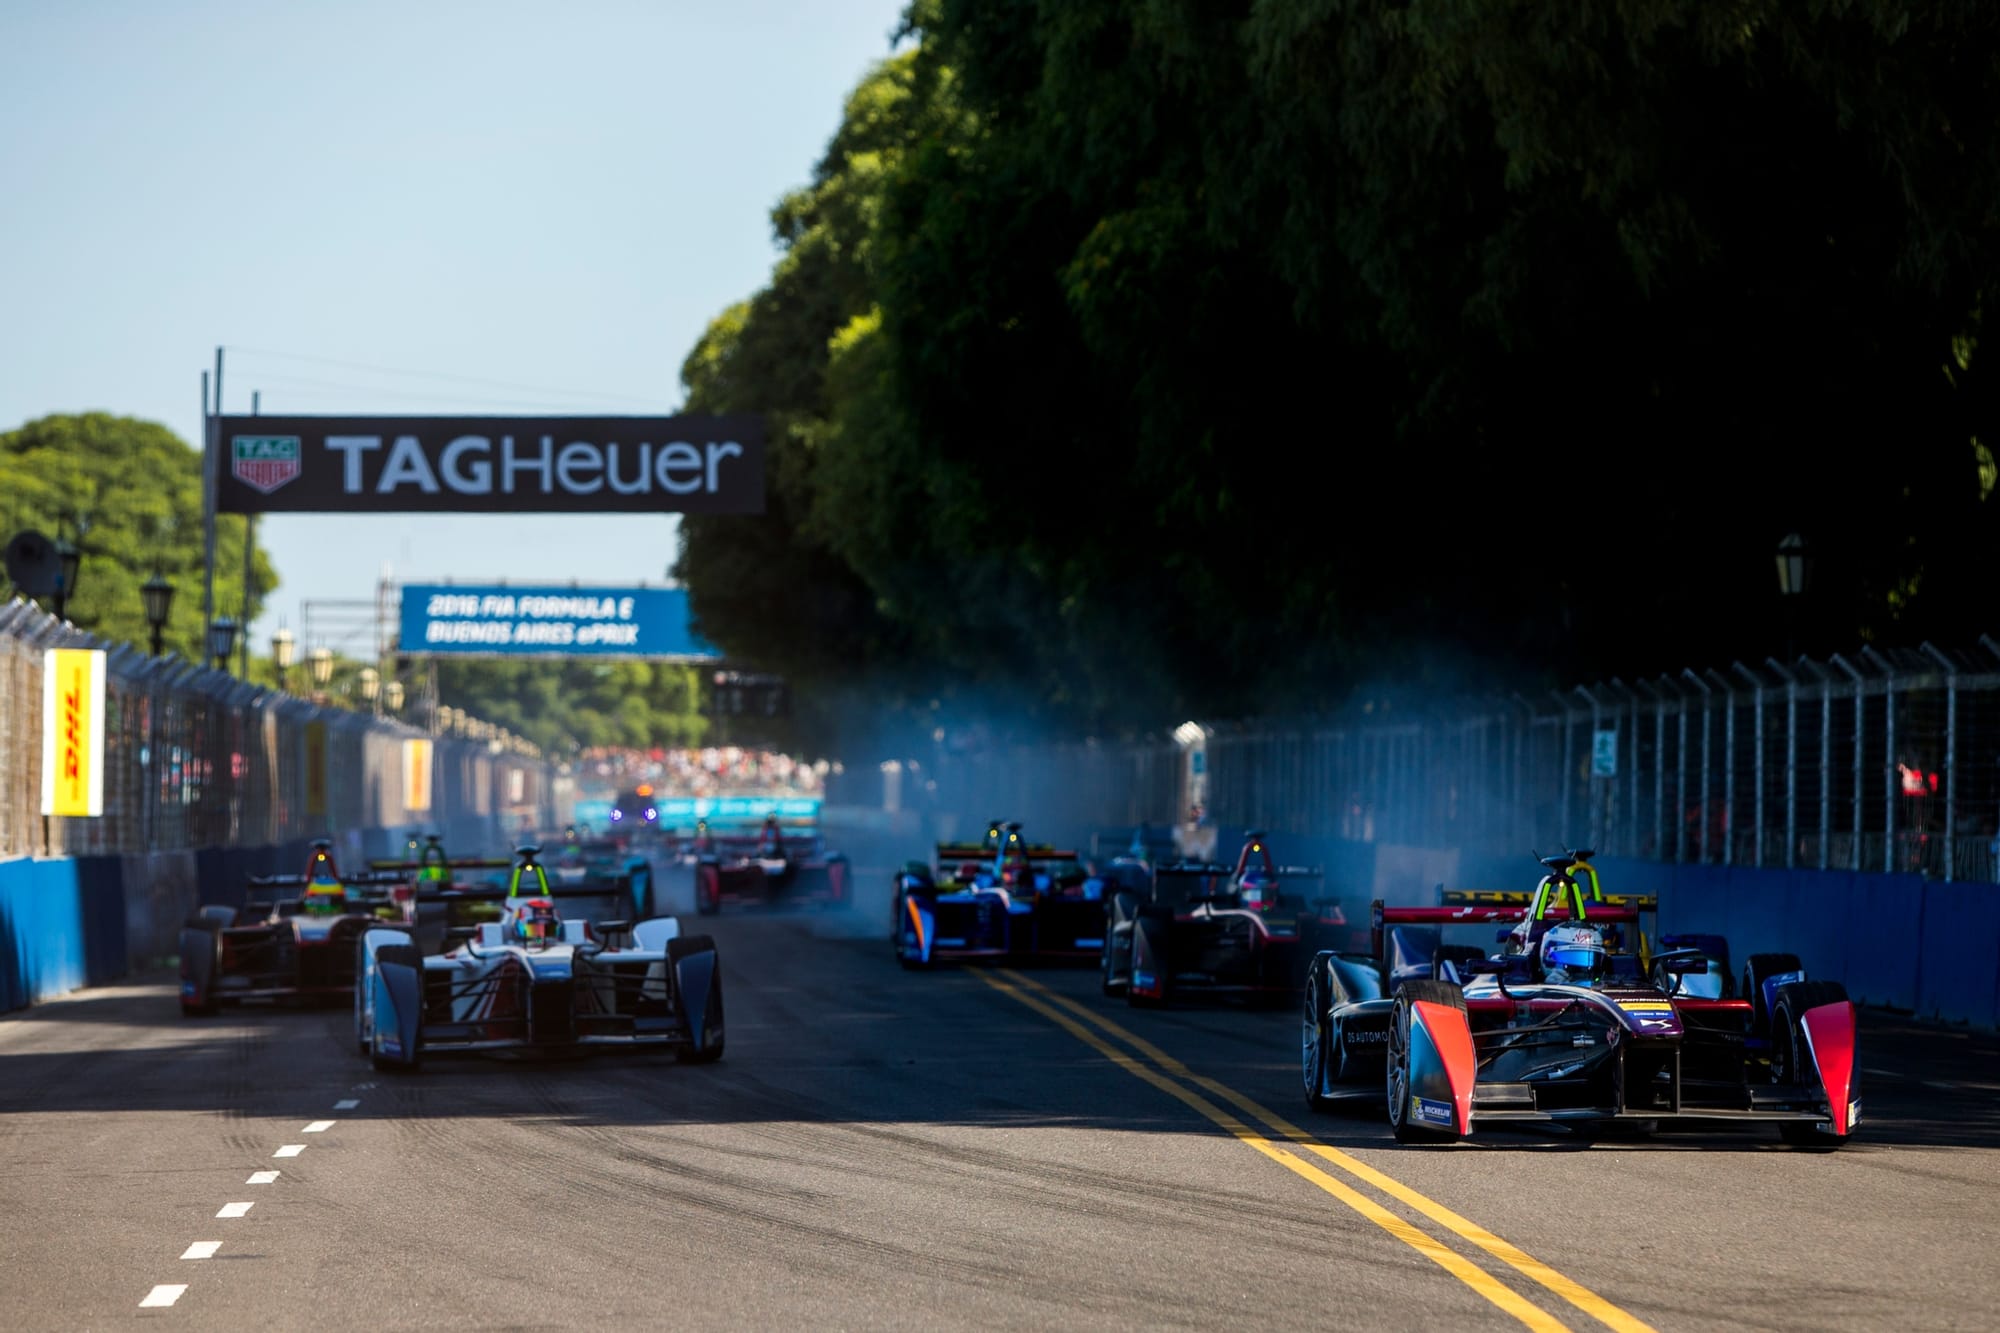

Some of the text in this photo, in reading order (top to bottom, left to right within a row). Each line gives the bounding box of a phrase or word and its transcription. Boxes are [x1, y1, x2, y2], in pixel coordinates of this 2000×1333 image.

[239, 438, 294, 458] TAG
[427, 594, 634, 620] 2016 FIA FORMULA E
[426, 620, 513, 644] BUENOS
[513, 622, 576, 645] AIRES
[65, 687, 80, 779] DHL
